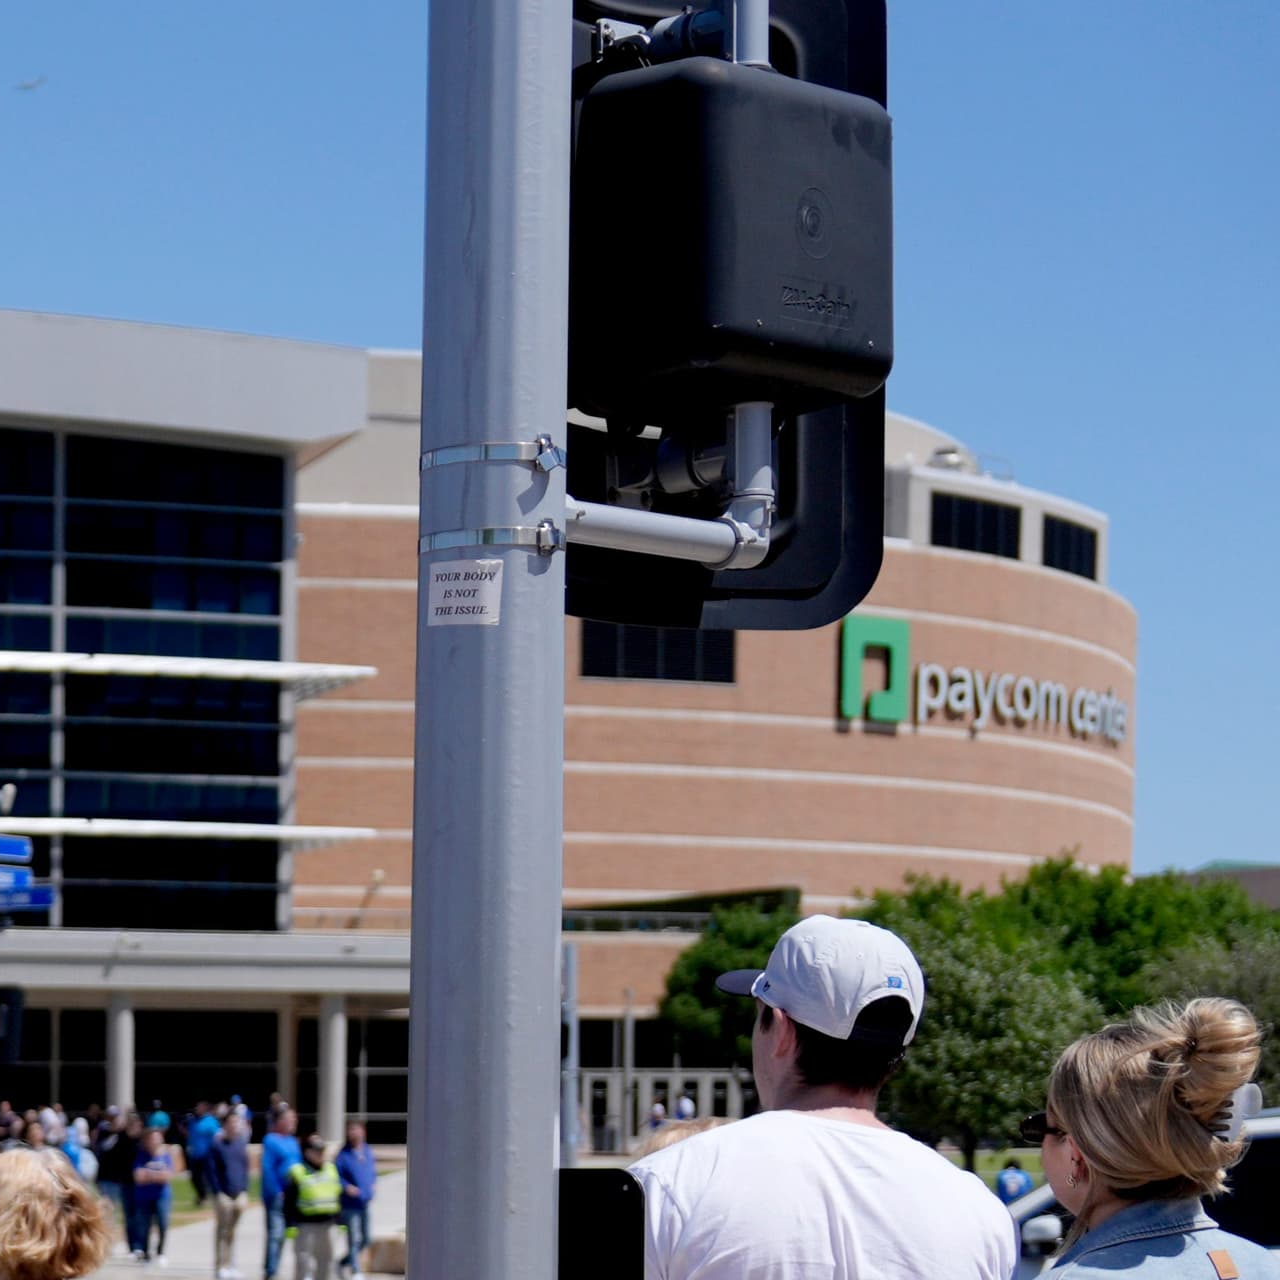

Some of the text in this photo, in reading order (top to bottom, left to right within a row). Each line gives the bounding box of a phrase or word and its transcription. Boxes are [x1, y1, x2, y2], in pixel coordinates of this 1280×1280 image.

[435, 571, 496, 583] YOUR BODY
[443, 588, 479, 599] IS NOT
[434, 605, 489, 616] THE ISSUE.
[917, 661, 1067, 731] paycom
